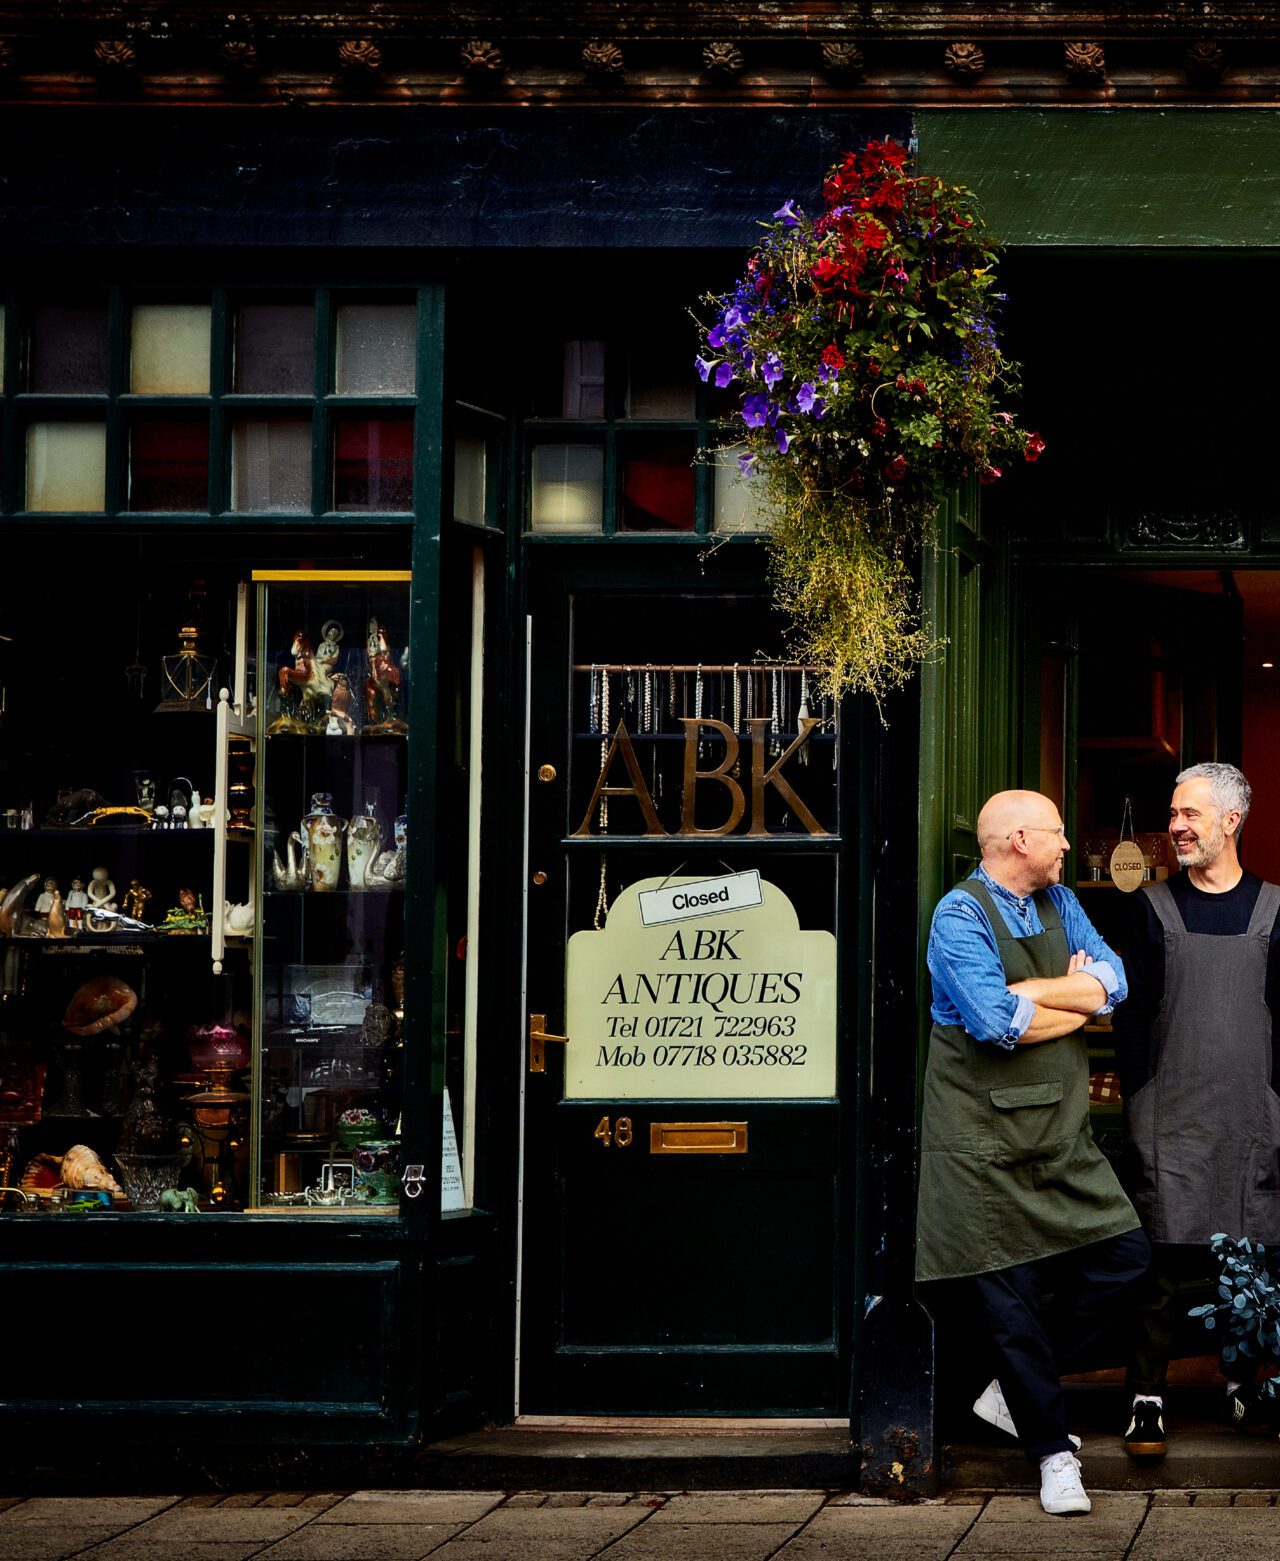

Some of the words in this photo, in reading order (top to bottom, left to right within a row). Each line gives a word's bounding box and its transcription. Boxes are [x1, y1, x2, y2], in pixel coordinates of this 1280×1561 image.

[570, 717, 831, 837] ABK
[1114, 862, 1142, 872] CLOSED
[671, 886, 730, 911] Closed
[658, 929, 744, 961] ABK
[600, 972, 803, 1012] ANTIQUES
[606, 1016, 639, 1038] Tel
[644, 1015, 703, 1038] 01721
[714, 1015, 797, 1038] 722963
[595, 1045, 646, 1067] Mob
[653, 1045, 717, 1067] 07718
[722, 1044, 808, 1067] 035882
[593, 1116, 633, 1147] 48
